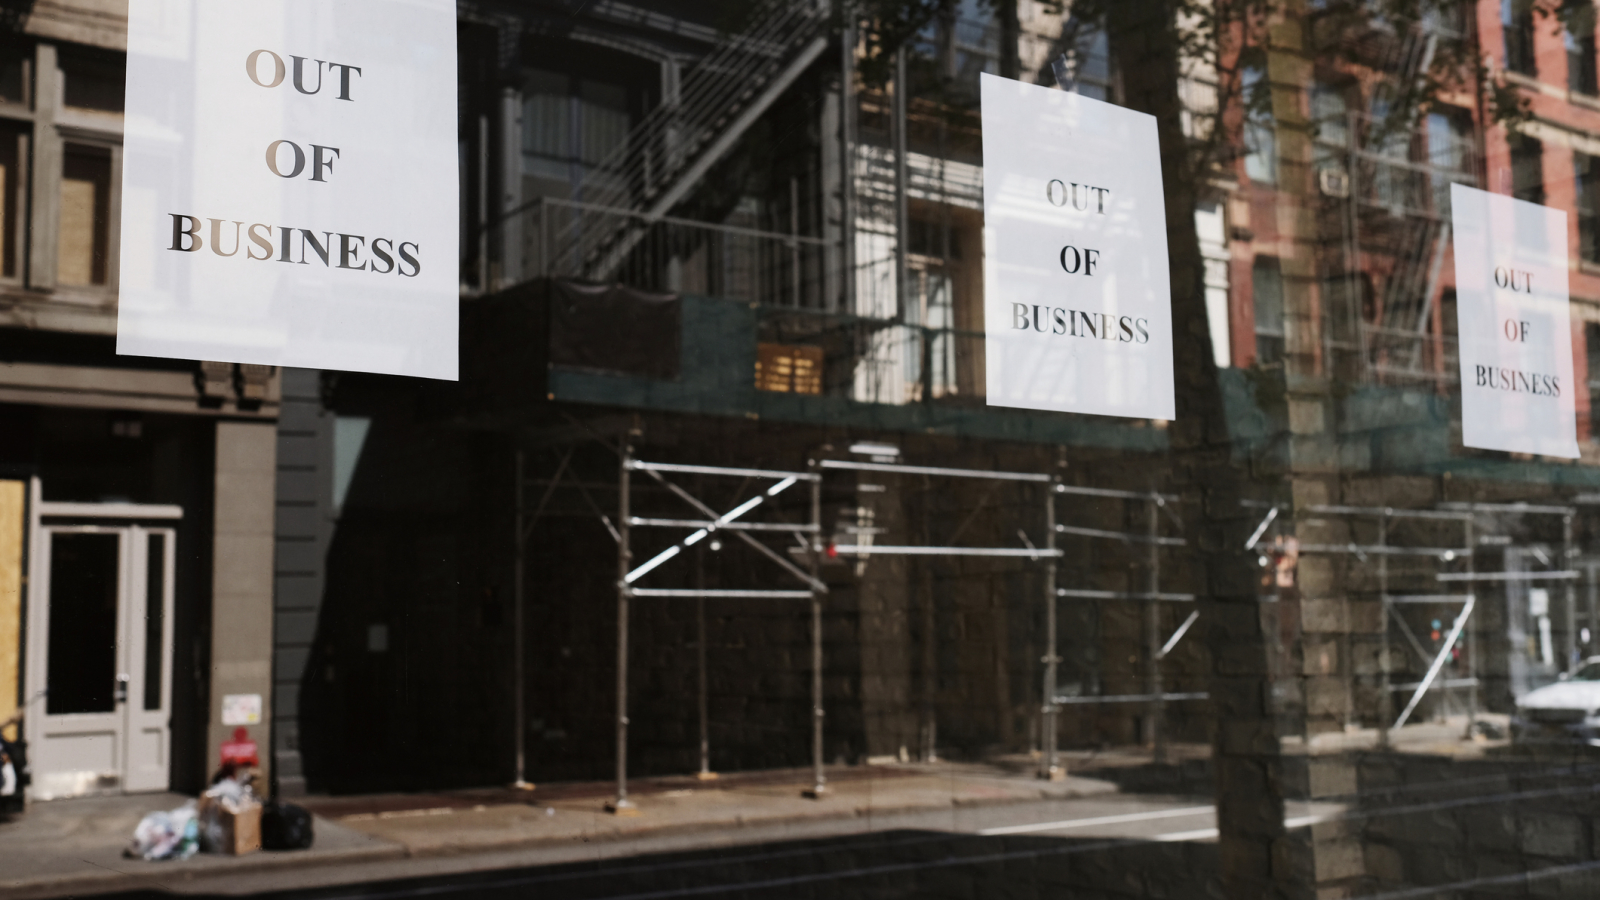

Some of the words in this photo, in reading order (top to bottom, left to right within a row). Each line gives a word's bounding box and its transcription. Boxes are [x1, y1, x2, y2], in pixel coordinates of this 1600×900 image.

[245, 49, 362, 102] OUT
[265, 139, 340, 183] OF
[1046, 178, 1110, 215] OUT
[167, 213, 421, 278] BUSINESS
[1060, 245, 1100, 276] OF
[1494, 265, 1534, 294] OUT
[1010, 302, 1149, 344] BUSINESS
[1504, 318, 1530, 343] OF
[1475, 364, 1561, 398] BUSINESS
